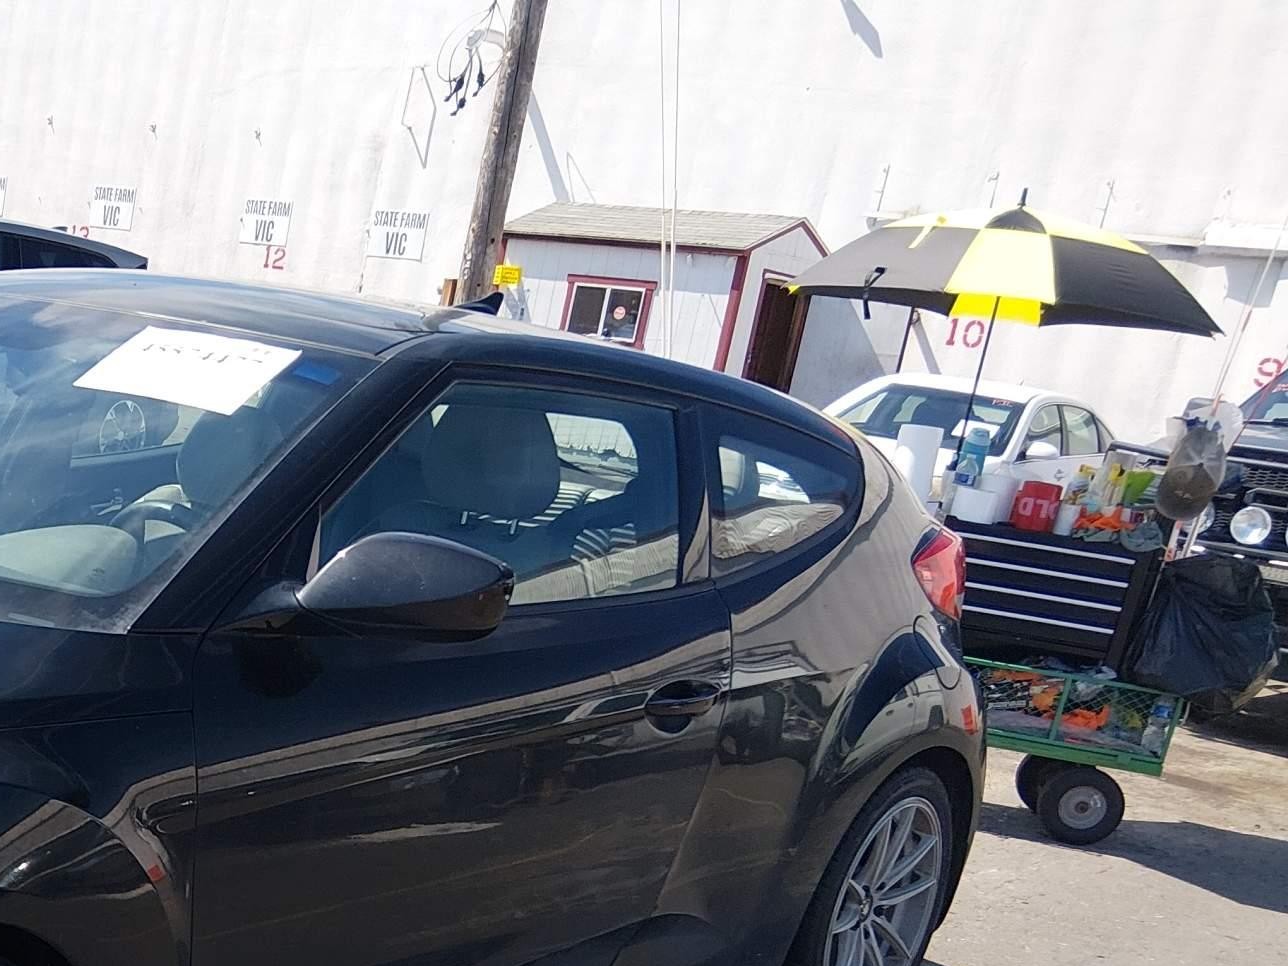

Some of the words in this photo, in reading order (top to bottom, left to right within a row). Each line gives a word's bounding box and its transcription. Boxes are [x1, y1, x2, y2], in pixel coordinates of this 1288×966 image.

[94, 186, 114, 201] STATE
[114, 188, 135, 203] FARM
[103, 205, 121, 226] VIC
[245, 199, 268, 216] STATE
[267, 200, 291, 217] FARM
[254, 219, 275, 242] VIC
[373, 210, 400, 228] STATE
[399, 211, 427, 230] FARM
[385, 231, 408, 256] VIC
[263, 245, 286, 270] 12
[945, 318, 985, 348] 10
[1253, 357, 1283, 388] 9
